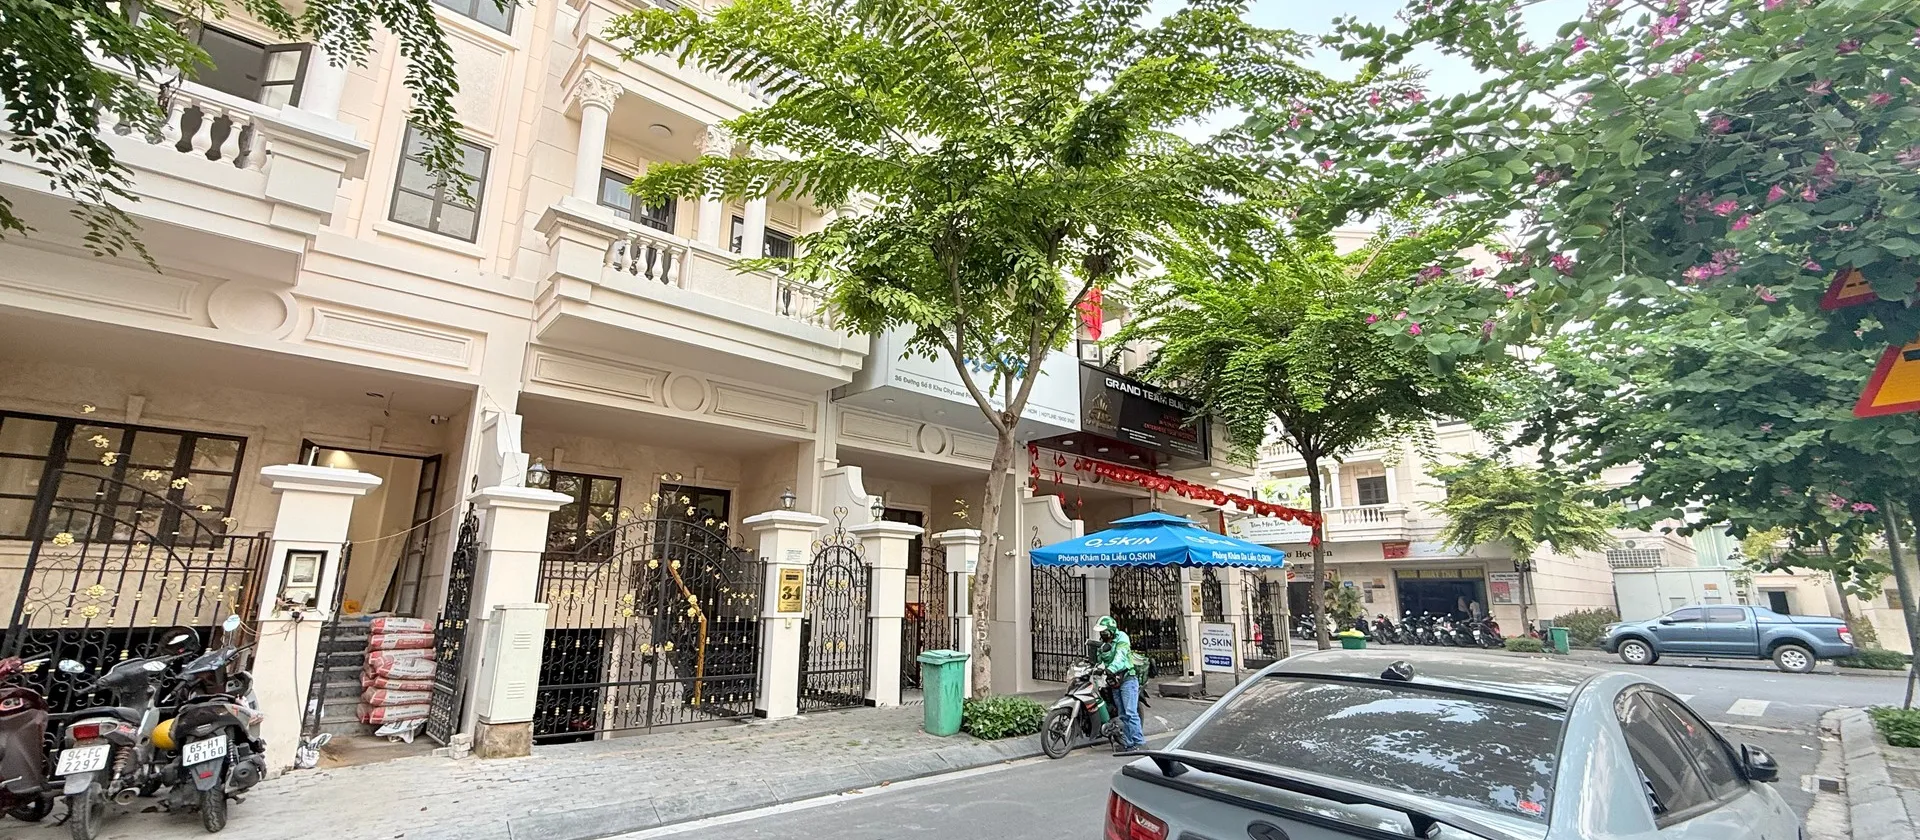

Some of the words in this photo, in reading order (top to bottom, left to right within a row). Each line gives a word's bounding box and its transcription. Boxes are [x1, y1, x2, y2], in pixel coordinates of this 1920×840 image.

[1105, 377, 1141, 396] GRAND
[1142, 389, 1168, 406] TEAM
[1080, 553, 1100, 562] Khám
[1100, 553, 1110, 561] Da
[1295, 550, 1313, 560] Học
[64, 758, 100, 772] 2297
